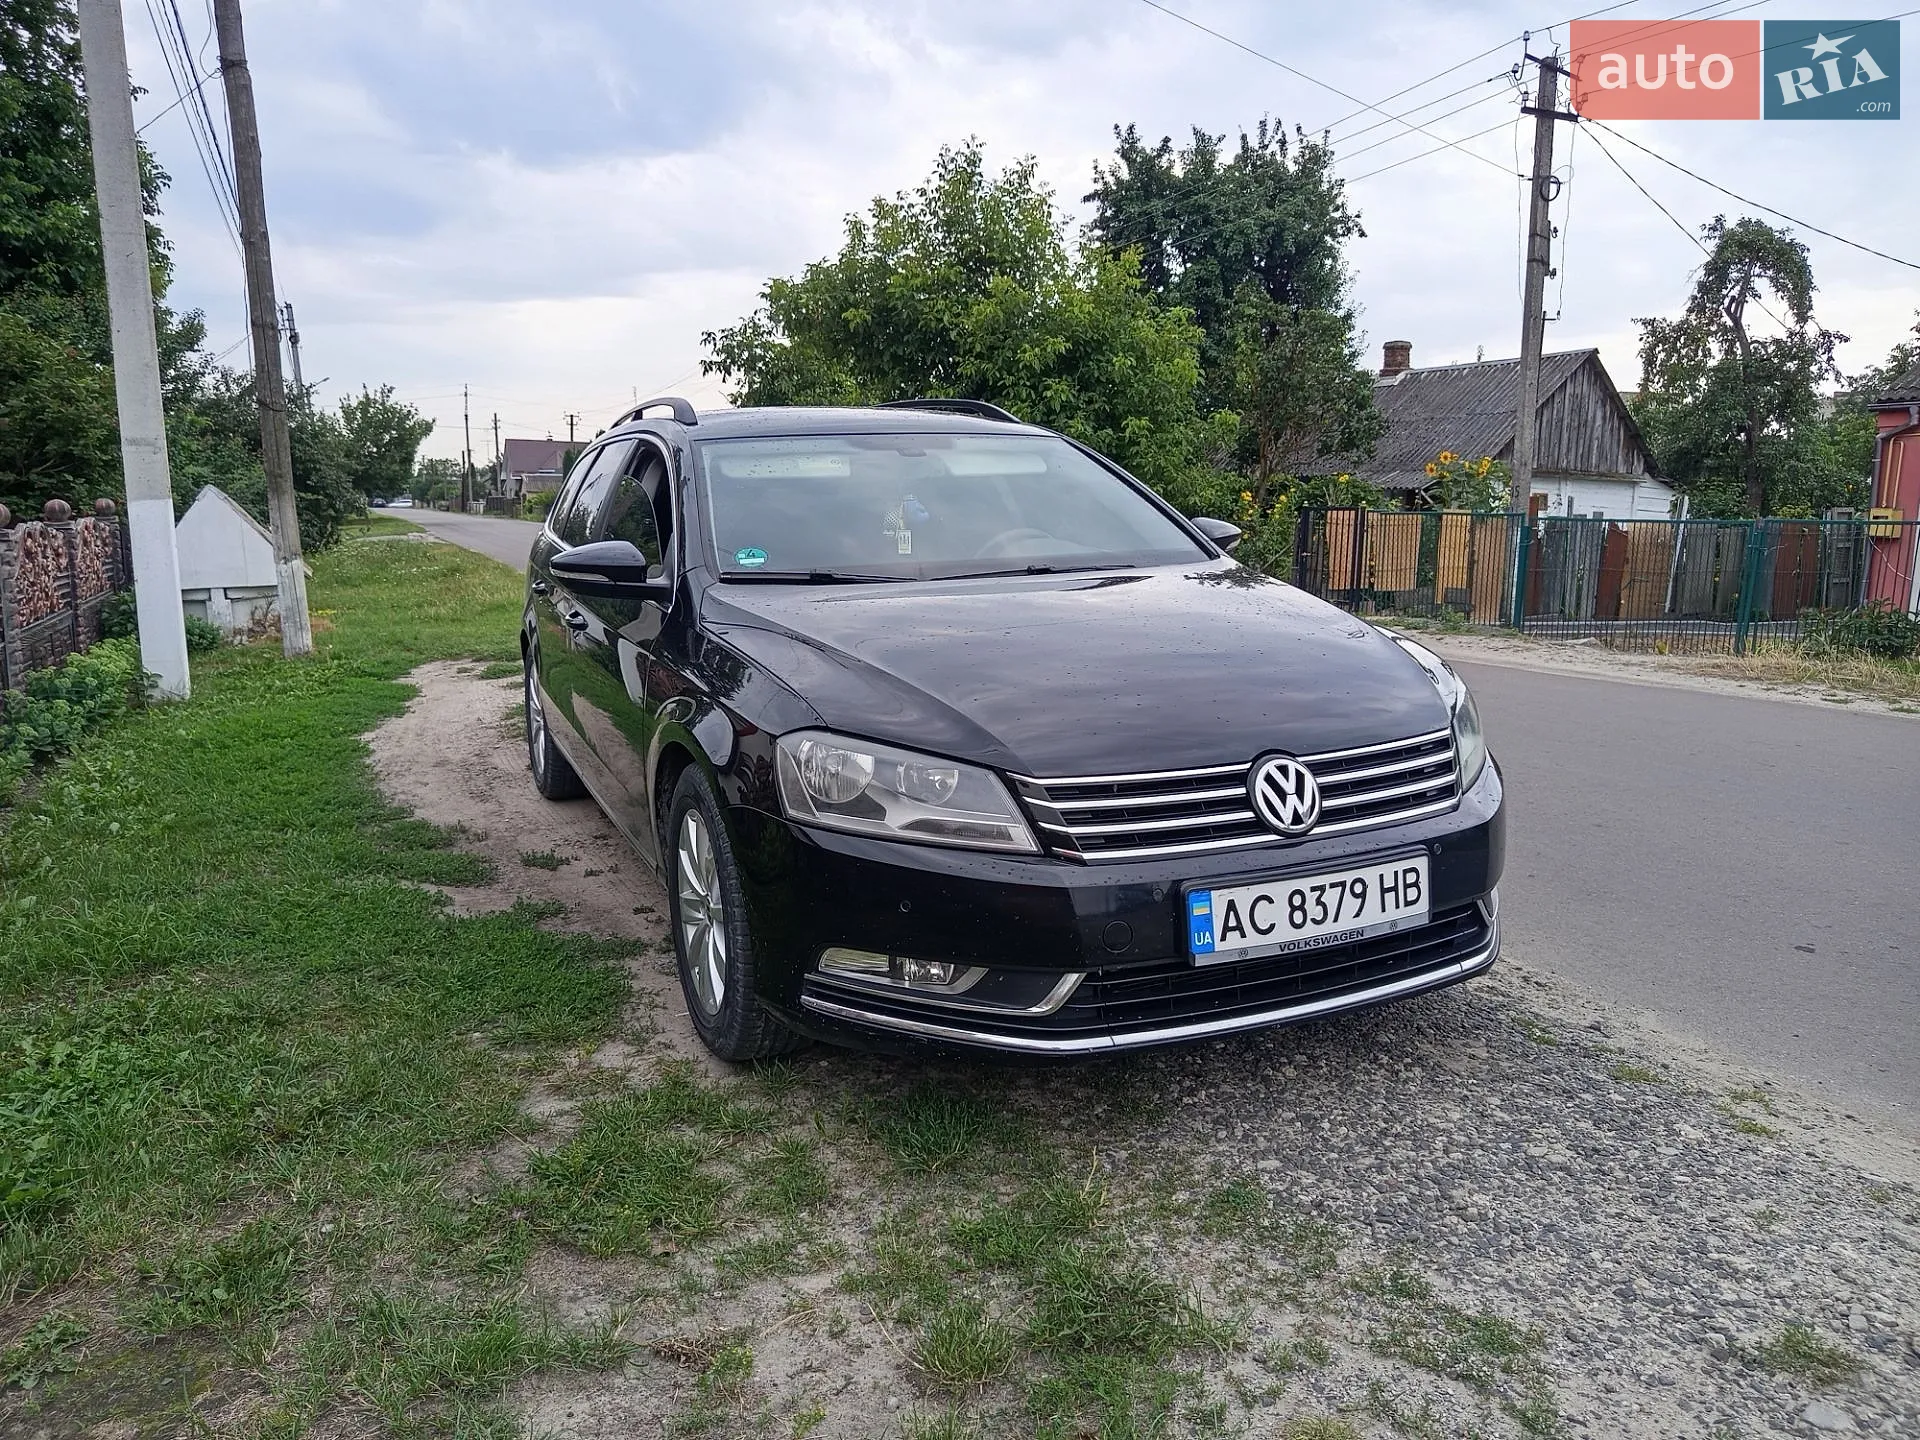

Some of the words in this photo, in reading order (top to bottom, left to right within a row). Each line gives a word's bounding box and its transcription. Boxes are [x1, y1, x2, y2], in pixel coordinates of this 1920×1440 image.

[1256, 759, 1318, 830] VW
[1219, 894, 1276, 942] AC
[1288, 876, 1369, 929] 8379
[1379, 866, 1422, 913] HB
[1194, 932, 1213, 946] UA
[1279, 929, 1365, 953] VOLKSWAGEN
